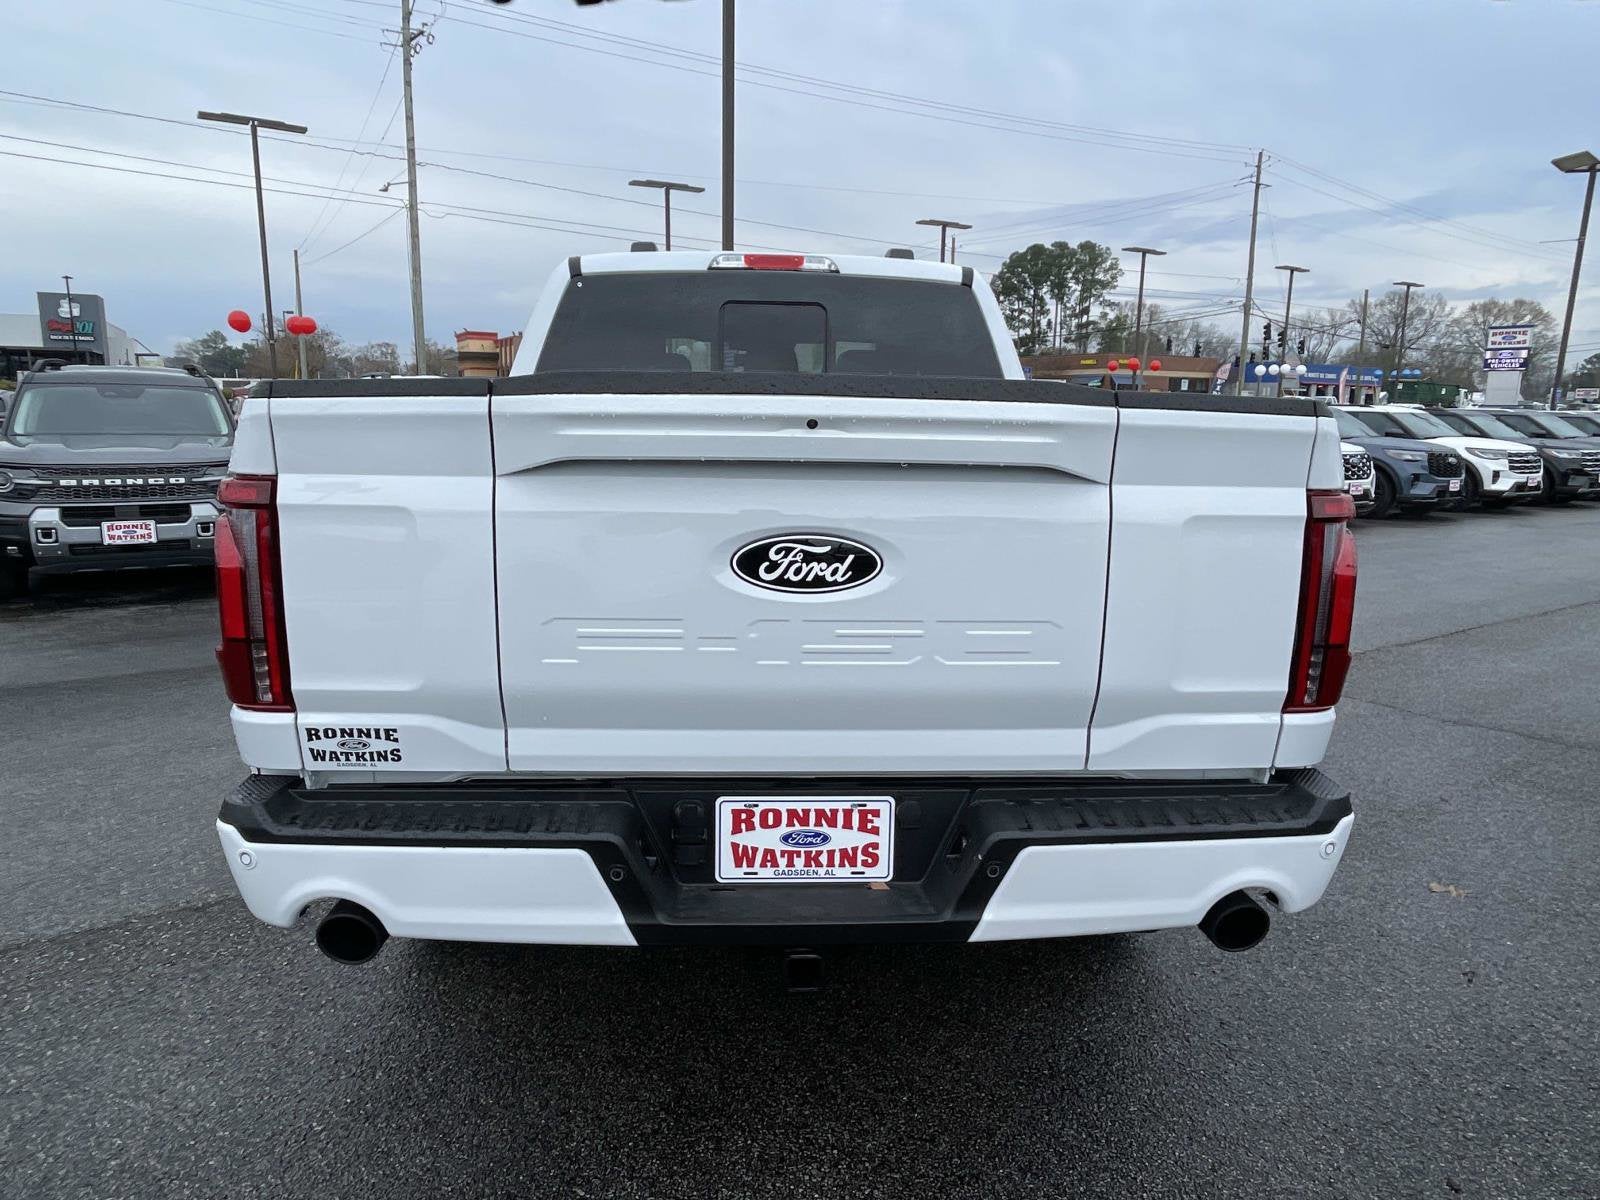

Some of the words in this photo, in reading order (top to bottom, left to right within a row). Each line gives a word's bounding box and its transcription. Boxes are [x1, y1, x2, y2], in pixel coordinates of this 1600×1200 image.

[60, 478, 185, 486] BRONCO
[106, 523, 152, 533] RONNIE
[107, 532, 153, 541] WATKINS
[758, 543, 853, 582] Ford
[305, 727, 399, 743] RONNIE
[308, 747, 402, 763] WATKINS
[730, 808, 881, 836] RONNIE
[786, 832, 824, 844] Ford
[730, 841, 880, 869] WATKINS
[773, 869, 821, 877] GADSDEN,
